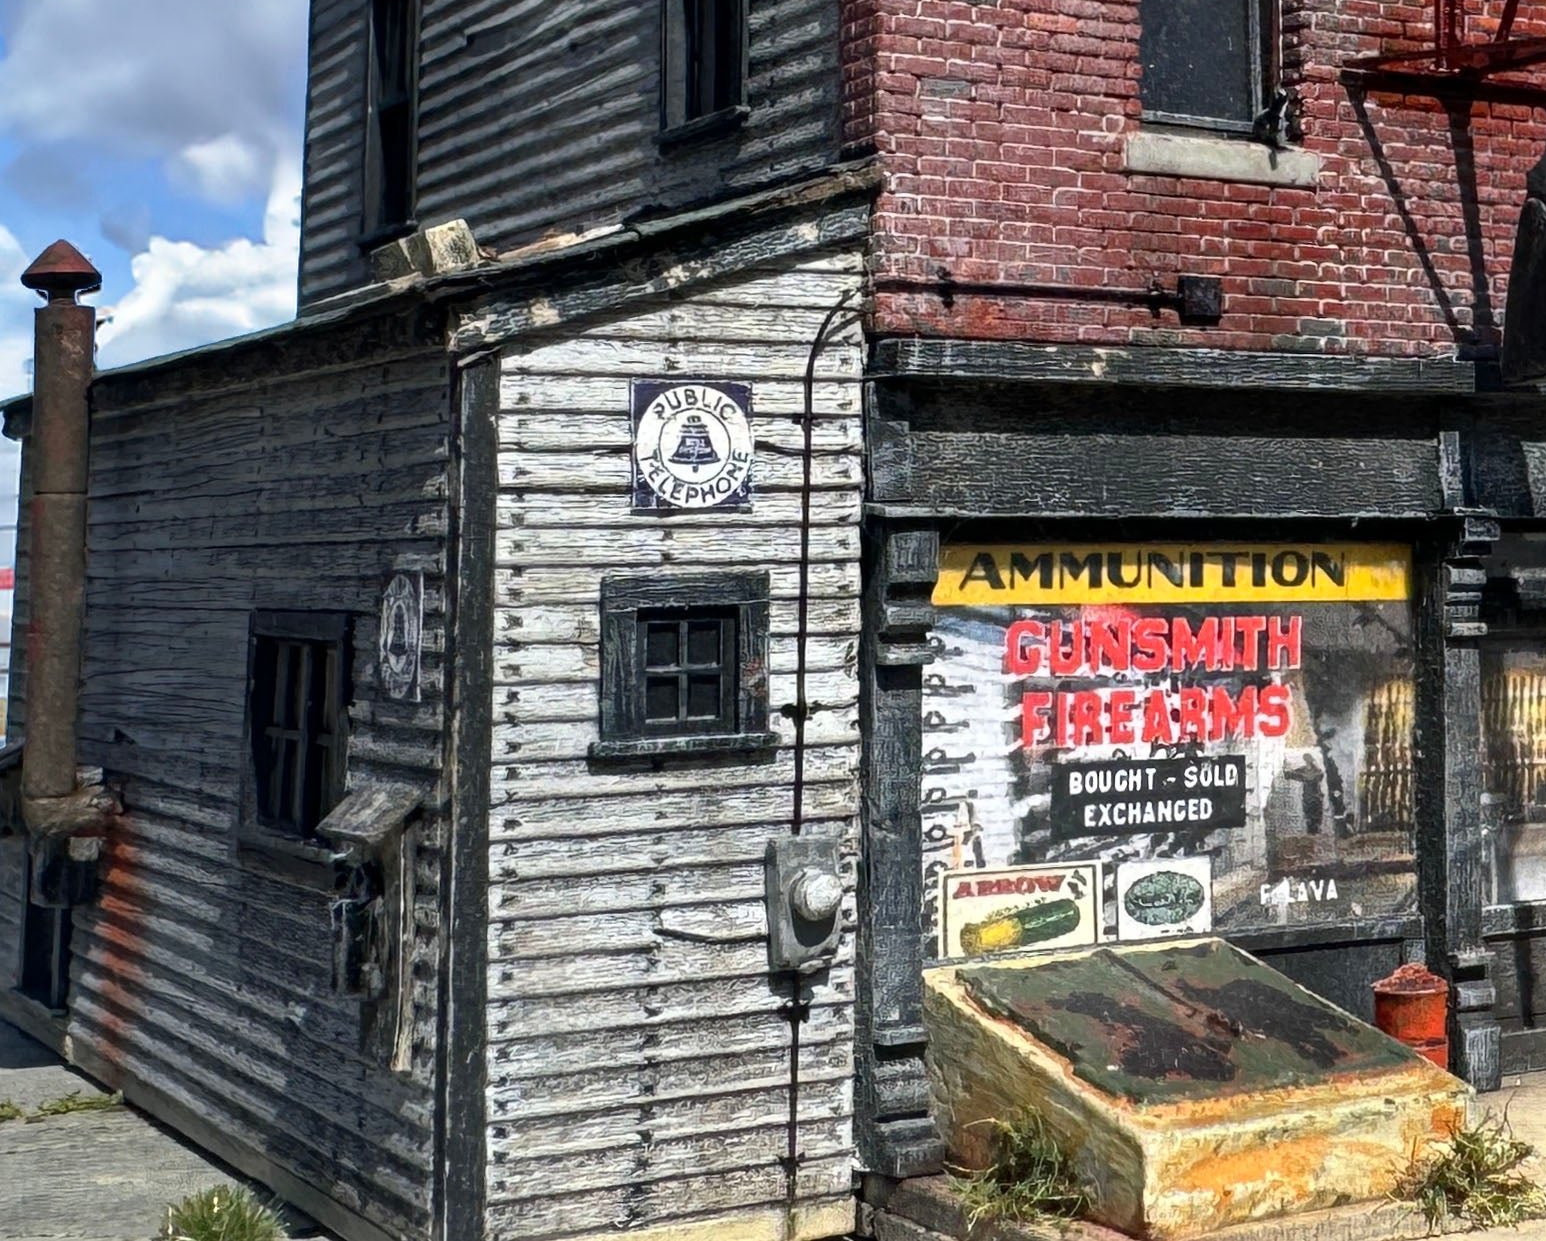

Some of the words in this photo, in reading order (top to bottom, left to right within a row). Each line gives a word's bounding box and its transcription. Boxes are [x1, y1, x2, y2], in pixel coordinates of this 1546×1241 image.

[653, 388, 737, 421] PUBLIC
[640, 448, 749, 504] TELEPHONE
[959, 550, 1346, 590] AMMUNITION
[1003, 616, 1303, 676] GUNSMITH
[1021, 683, 1294, 749] FIREARMS
[1069, 767, 1157, 795] BOUGHT
[1183, 763, 1239, 788] SOLD
[1084, 797, 1213, 828] EXCHANGED
[952, 874, 1067, 900] ARROW
